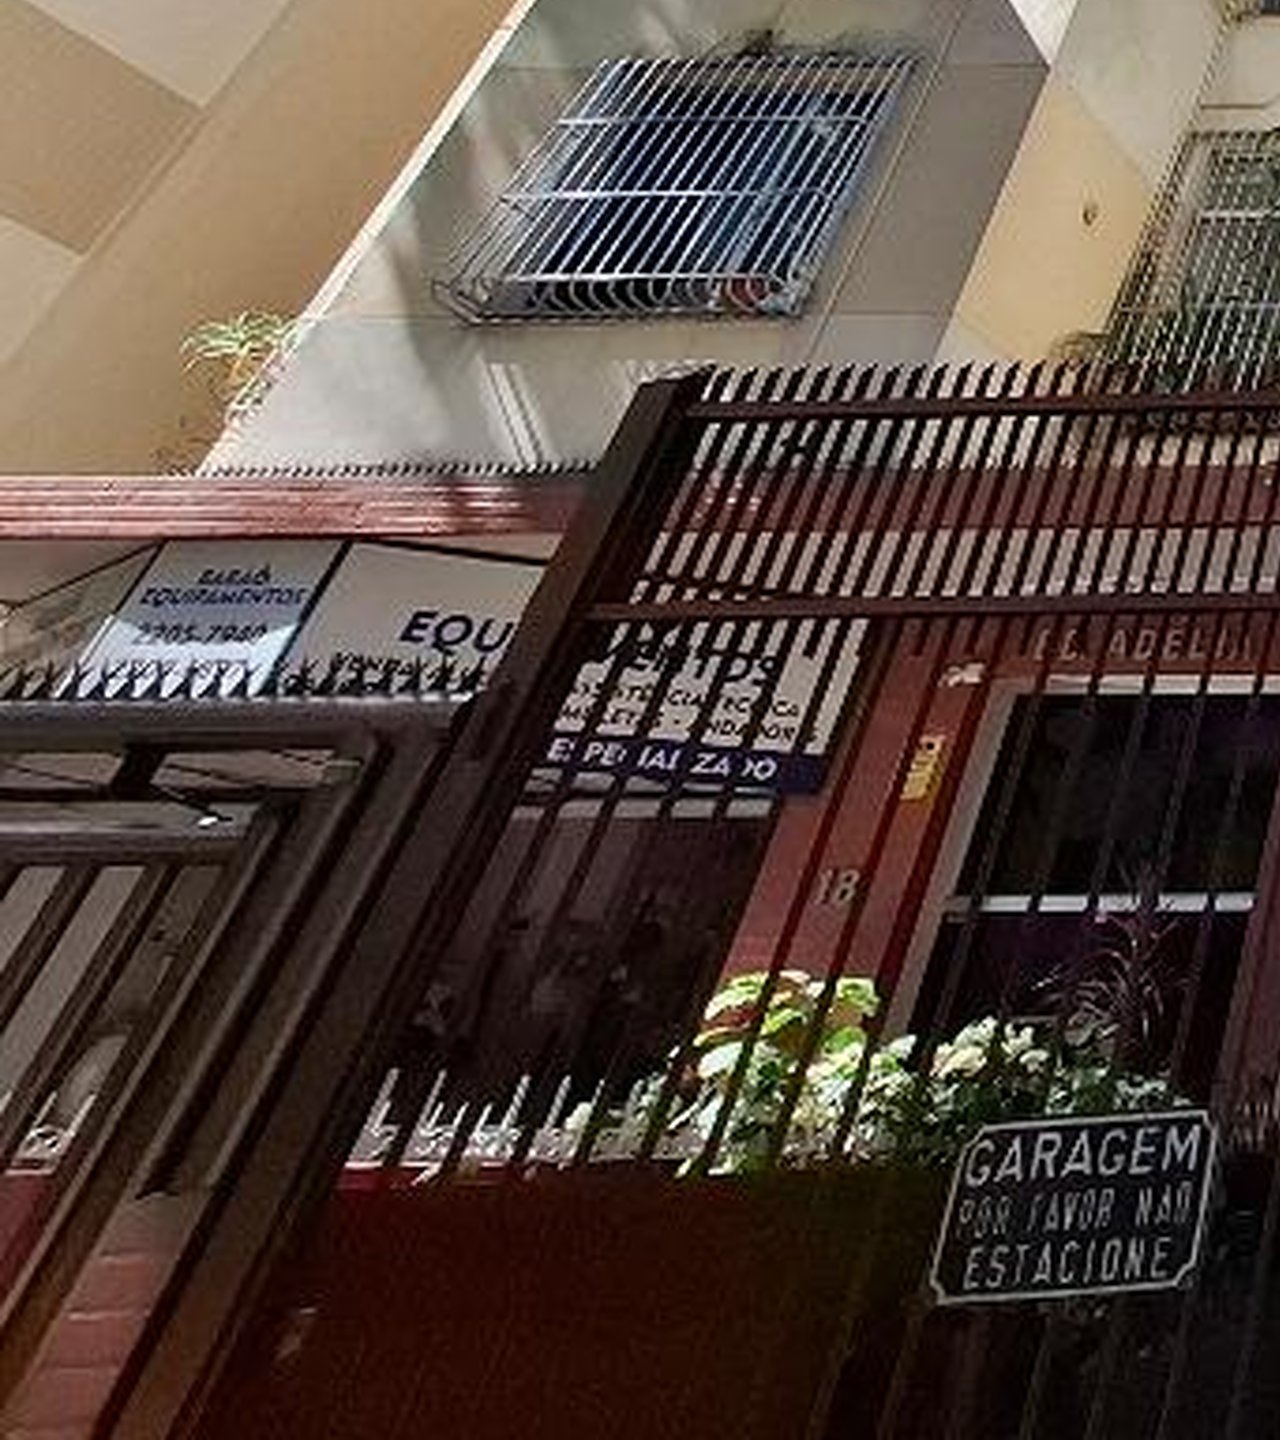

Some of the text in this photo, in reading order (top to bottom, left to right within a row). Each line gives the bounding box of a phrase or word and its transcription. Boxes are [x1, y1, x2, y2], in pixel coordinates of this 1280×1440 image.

[964, 1123, 1202, 1187] GARAGEM
[1026, 1187, 1115, 1232] FAVOR
[963, 1236, 1172, 1290] ESTACIONE
